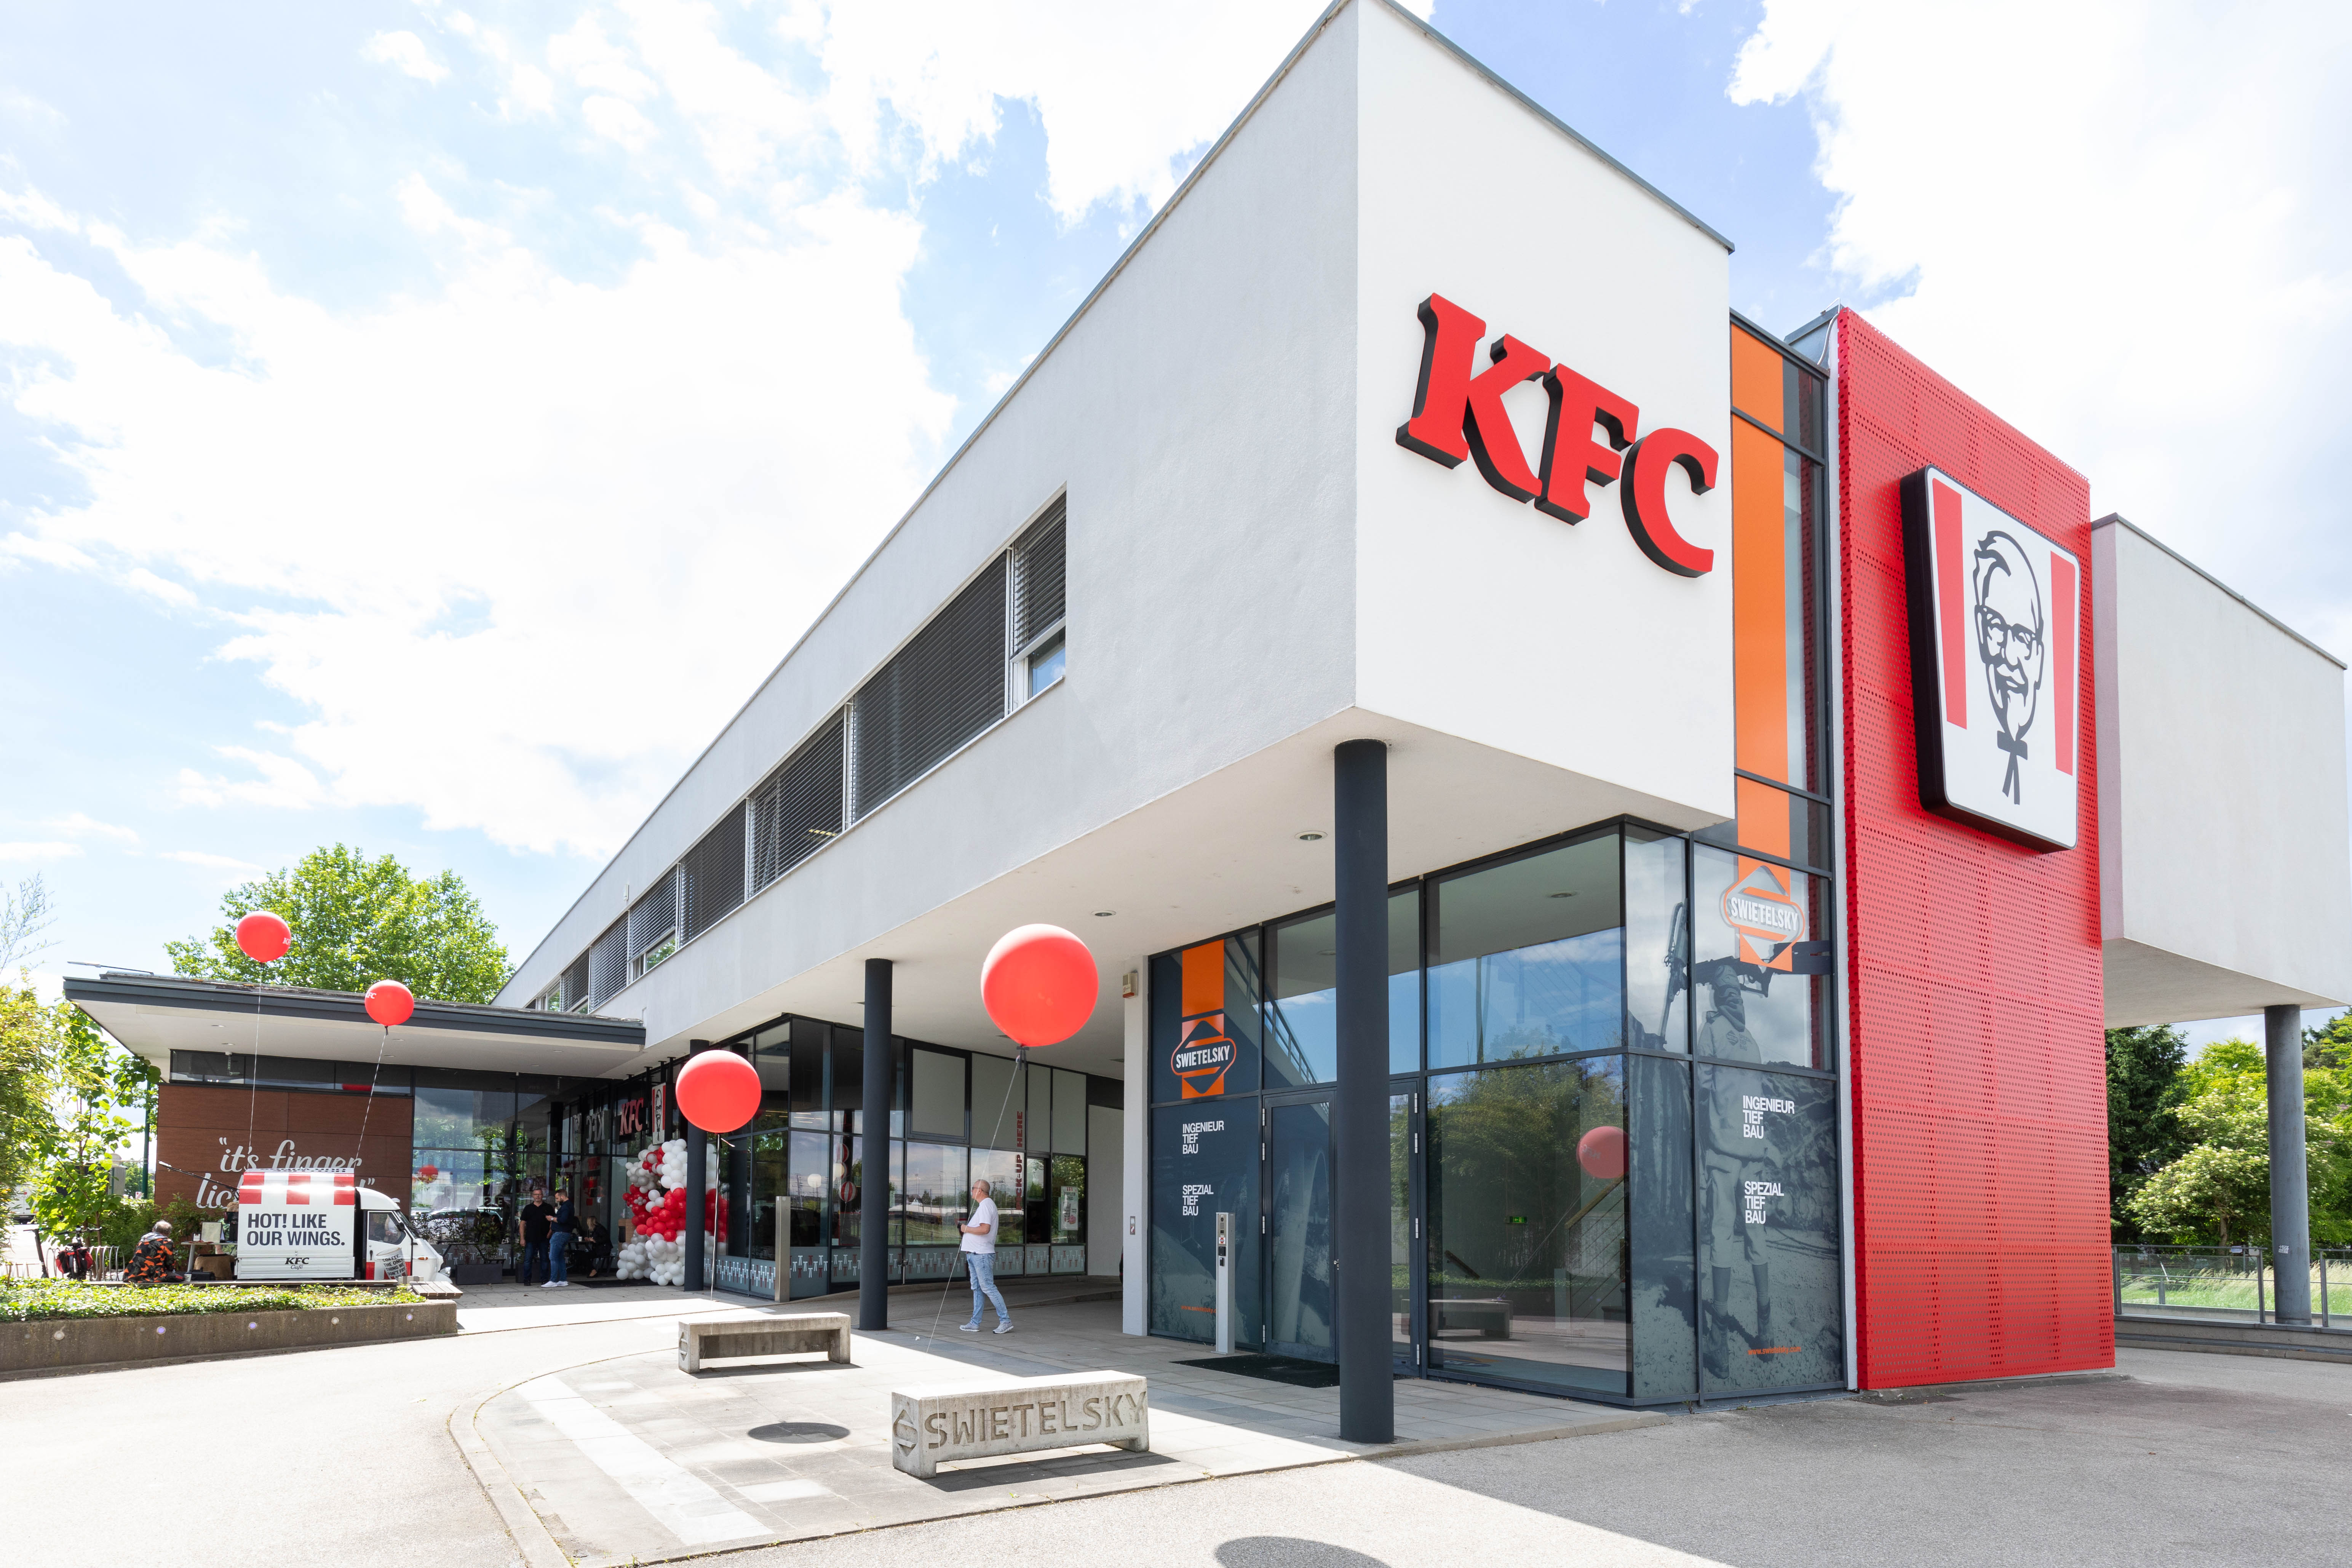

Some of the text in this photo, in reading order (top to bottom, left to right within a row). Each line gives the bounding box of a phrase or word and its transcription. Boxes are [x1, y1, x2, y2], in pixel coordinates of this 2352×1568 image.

[1395, 293, 1719, 578] KFC
[1731, 897, 1798, 930] SWIETELSKY
[1176, 1045, 1230, 1068] SWIETELSKY
[1743, 1095, 1795, 1114] INGENIEUR
[619, 1097, 644, 1135] KFC
[1743, 1110, 1764, 1124] TIEF
[1182, 1120, 1224, 1133] INGENIEUR
[1743, 1124, 1764, 1139] BAU
[1182, 1133, 1198, 1144] TIEF
[1182, 1144, 1198, 1154] BAU
[1182, 1184, 1214, 1195] SPEZIAL
[1745, 1181, 1784, 1196] SPEZIAL
[1182, 1196, 1198, 1205] TIEF
[1745, 1196, 1766, 1209] TIEF
[1182, 1206, 1198, 1216] BAU
[1745, 1210, 1766, 1224] BAU
[248, 1213, 327, 1228] HOT! LIKE
[247, 1231, 345, 1245] OUR WINGS.
[924, 1391, 1146, 1449] SWIETELSKY
